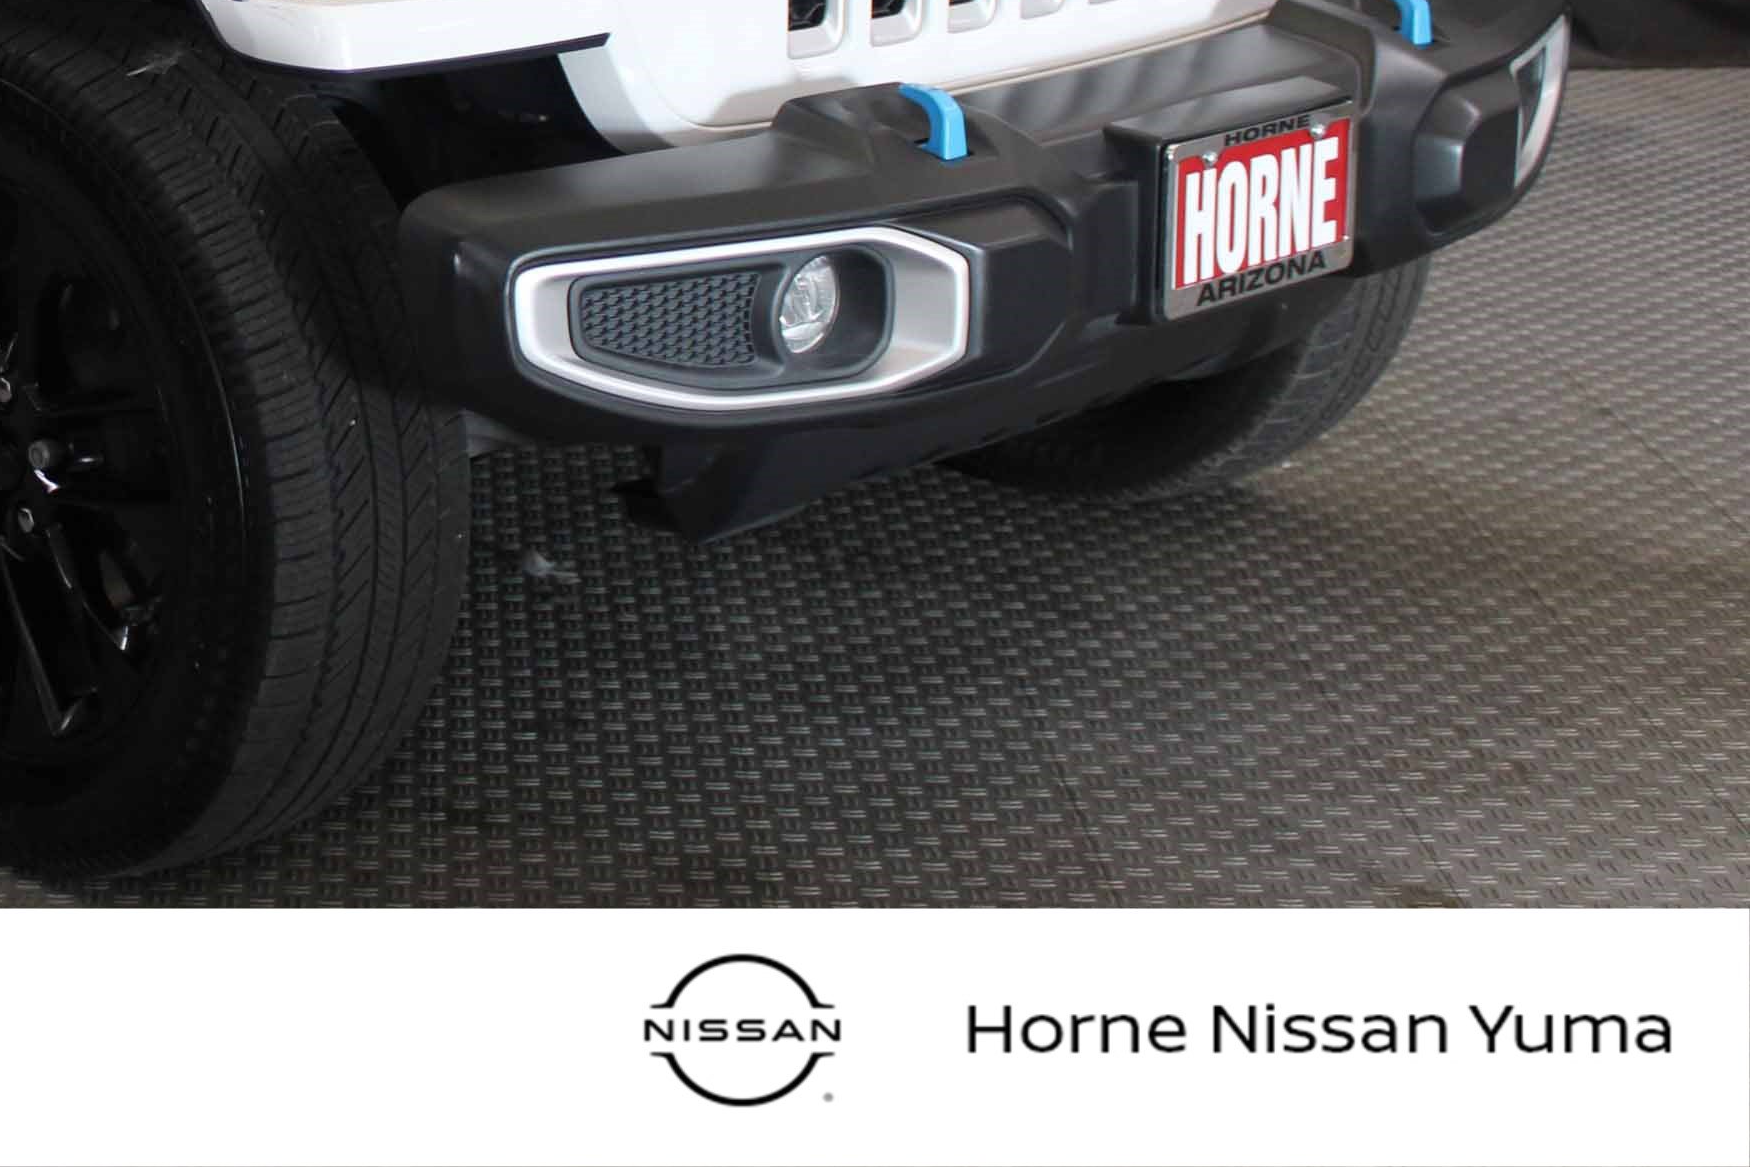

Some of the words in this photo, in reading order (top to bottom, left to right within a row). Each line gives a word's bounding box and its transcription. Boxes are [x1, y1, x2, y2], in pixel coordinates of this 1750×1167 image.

[1223, 114, 1310, 146] HORNE
[1183, 136, 1339, 285] HORNE
[1196, 250, 1326, 306] ARIZONA
